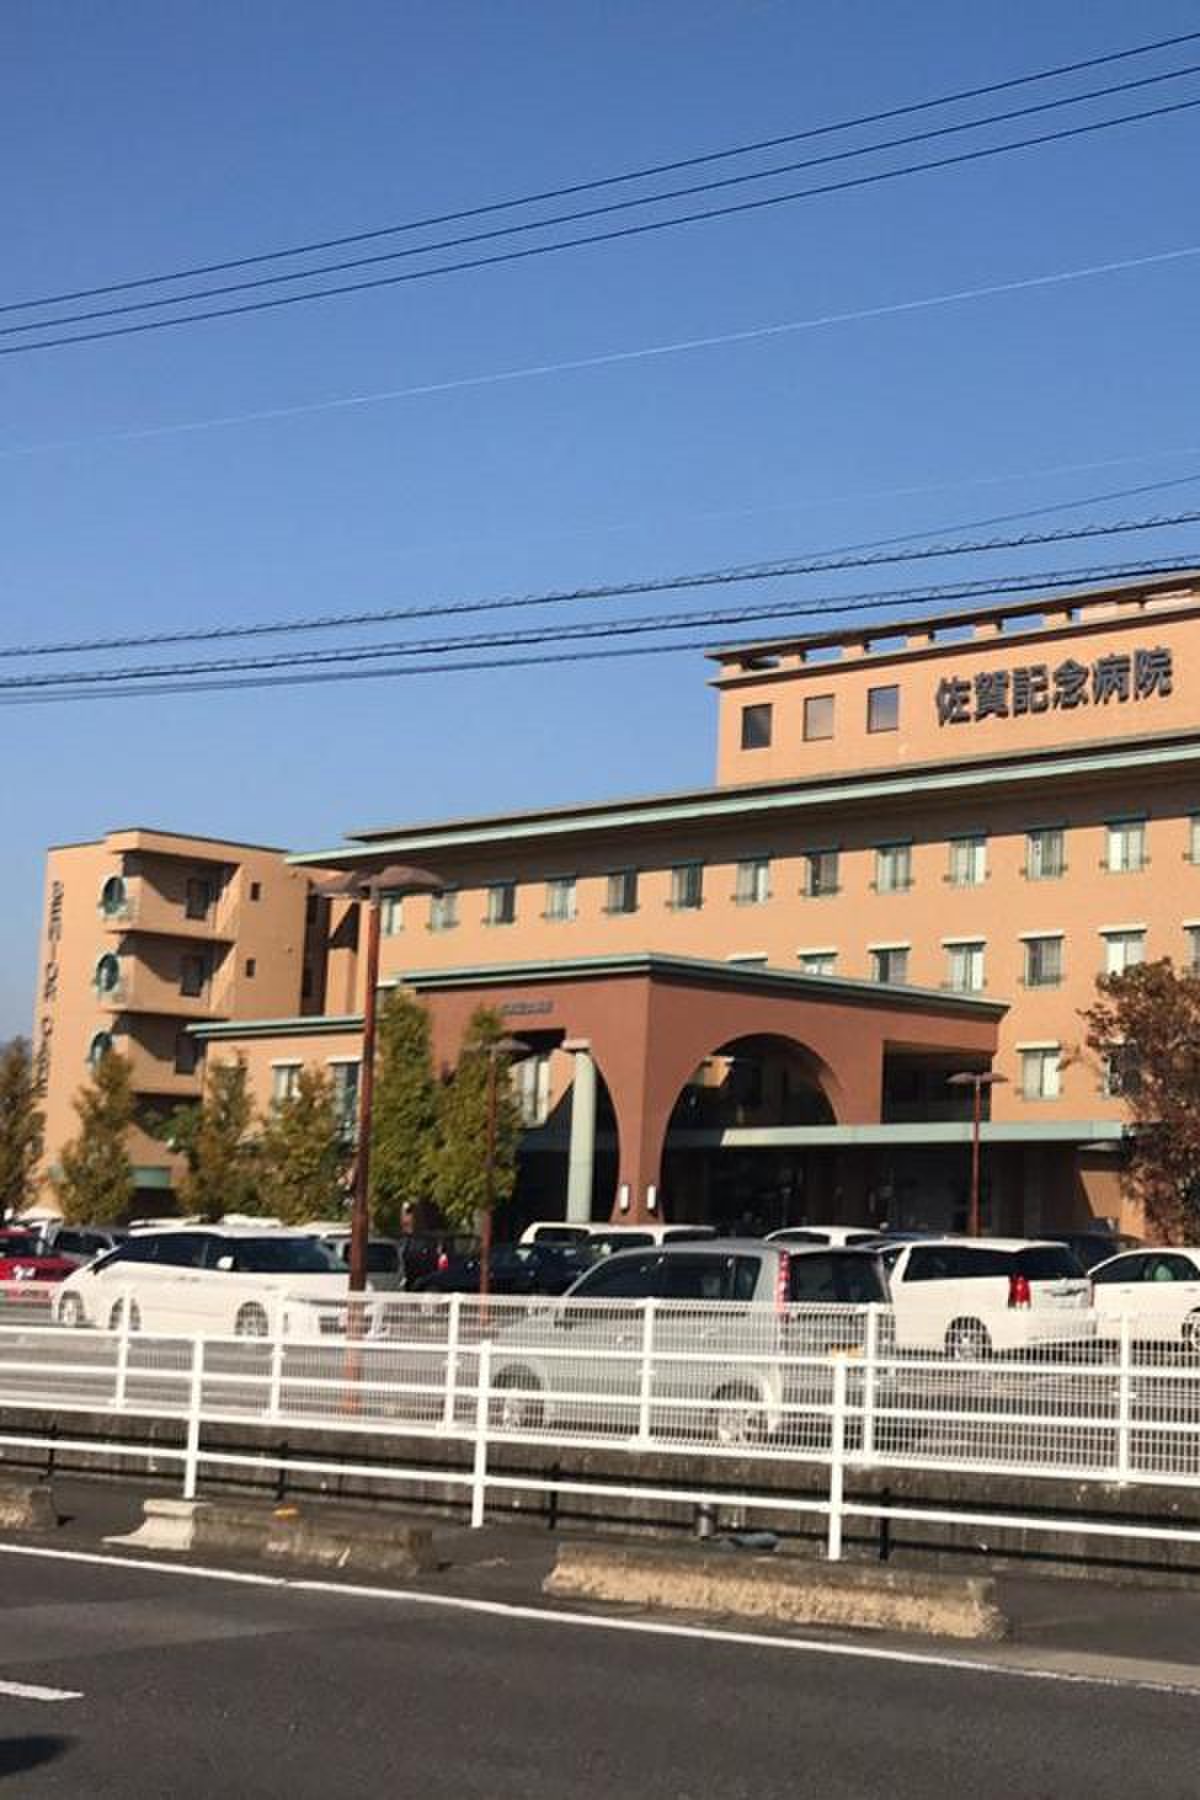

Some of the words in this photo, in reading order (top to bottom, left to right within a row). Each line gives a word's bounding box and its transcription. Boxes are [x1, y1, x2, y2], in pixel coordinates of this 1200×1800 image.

[935, 646, 1172, 727] 佐賀記念病院
